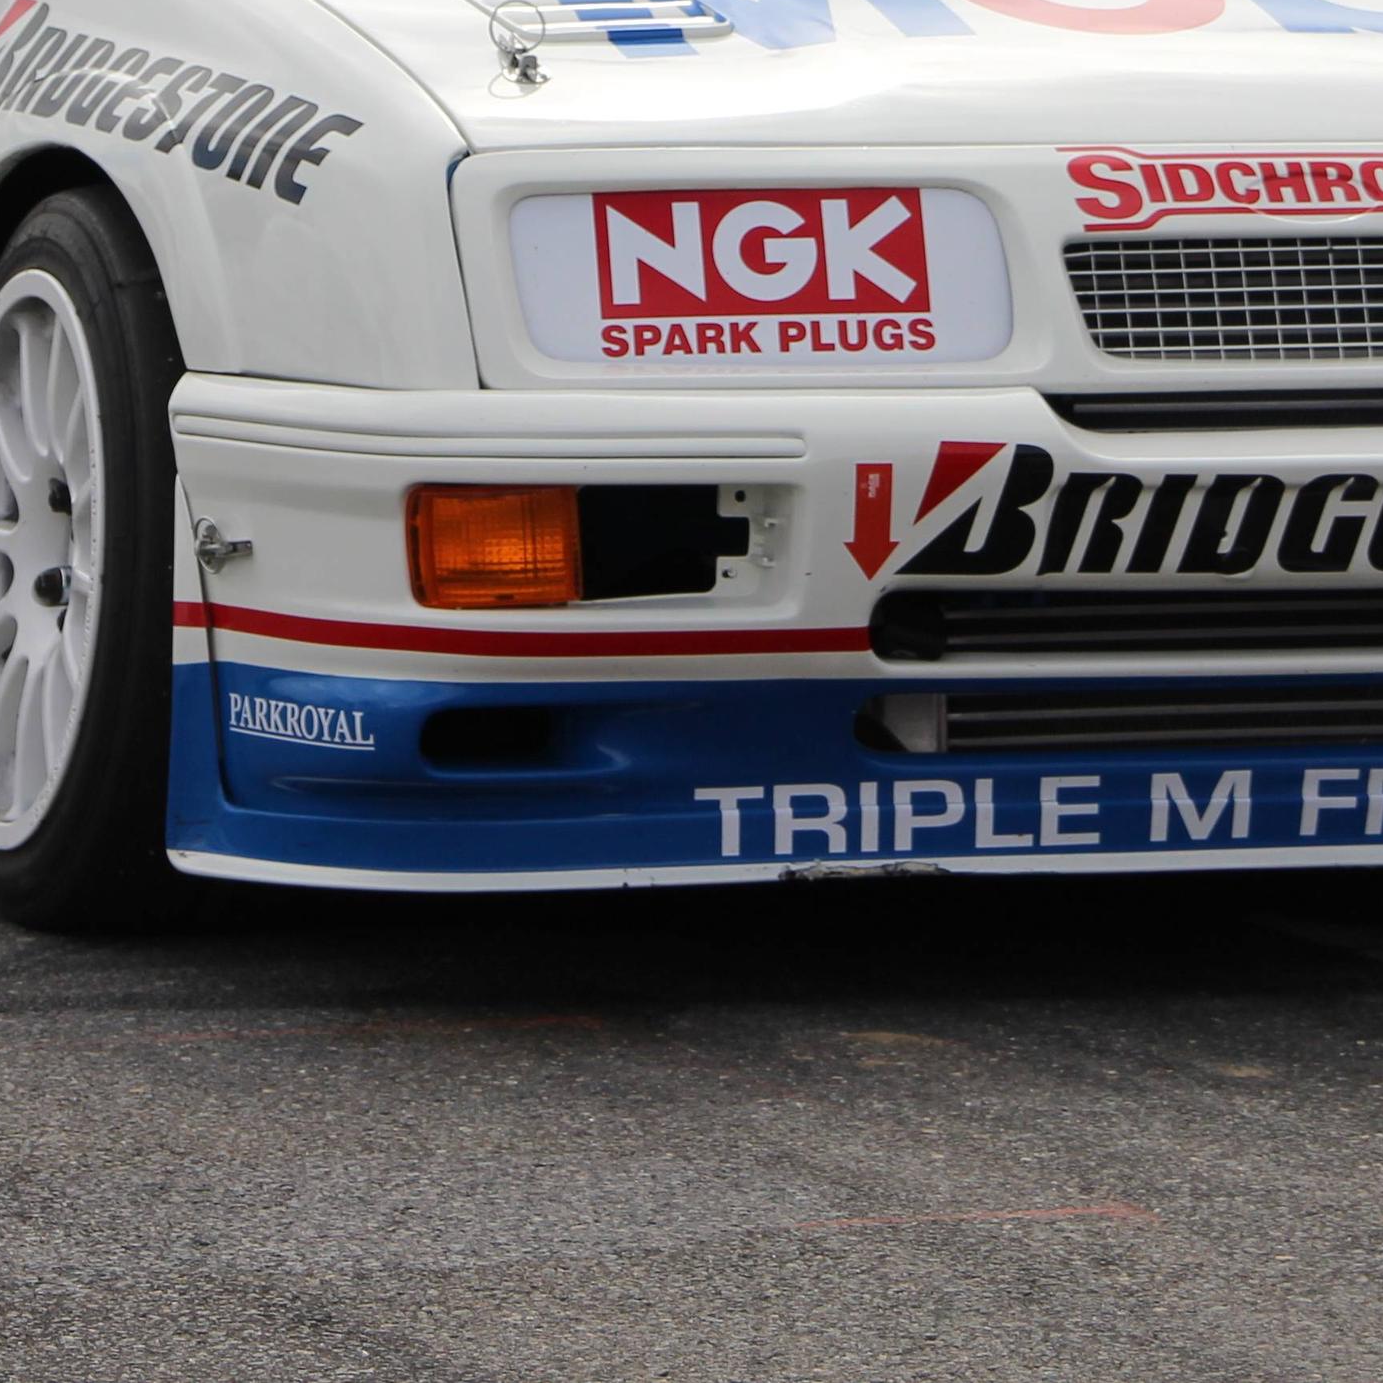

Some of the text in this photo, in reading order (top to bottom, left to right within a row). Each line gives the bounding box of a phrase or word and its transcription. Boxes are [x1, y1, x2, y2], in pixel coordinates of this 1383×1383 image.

[604, 194, 918, 307] NGK
[600, 318, 937, 358] SPARK PLUGS
[229, 693, 375, 746] PARKROYAL
[693, 774, 1102, 857] TRIPLE
[1149, 769, 1253, 843] M
